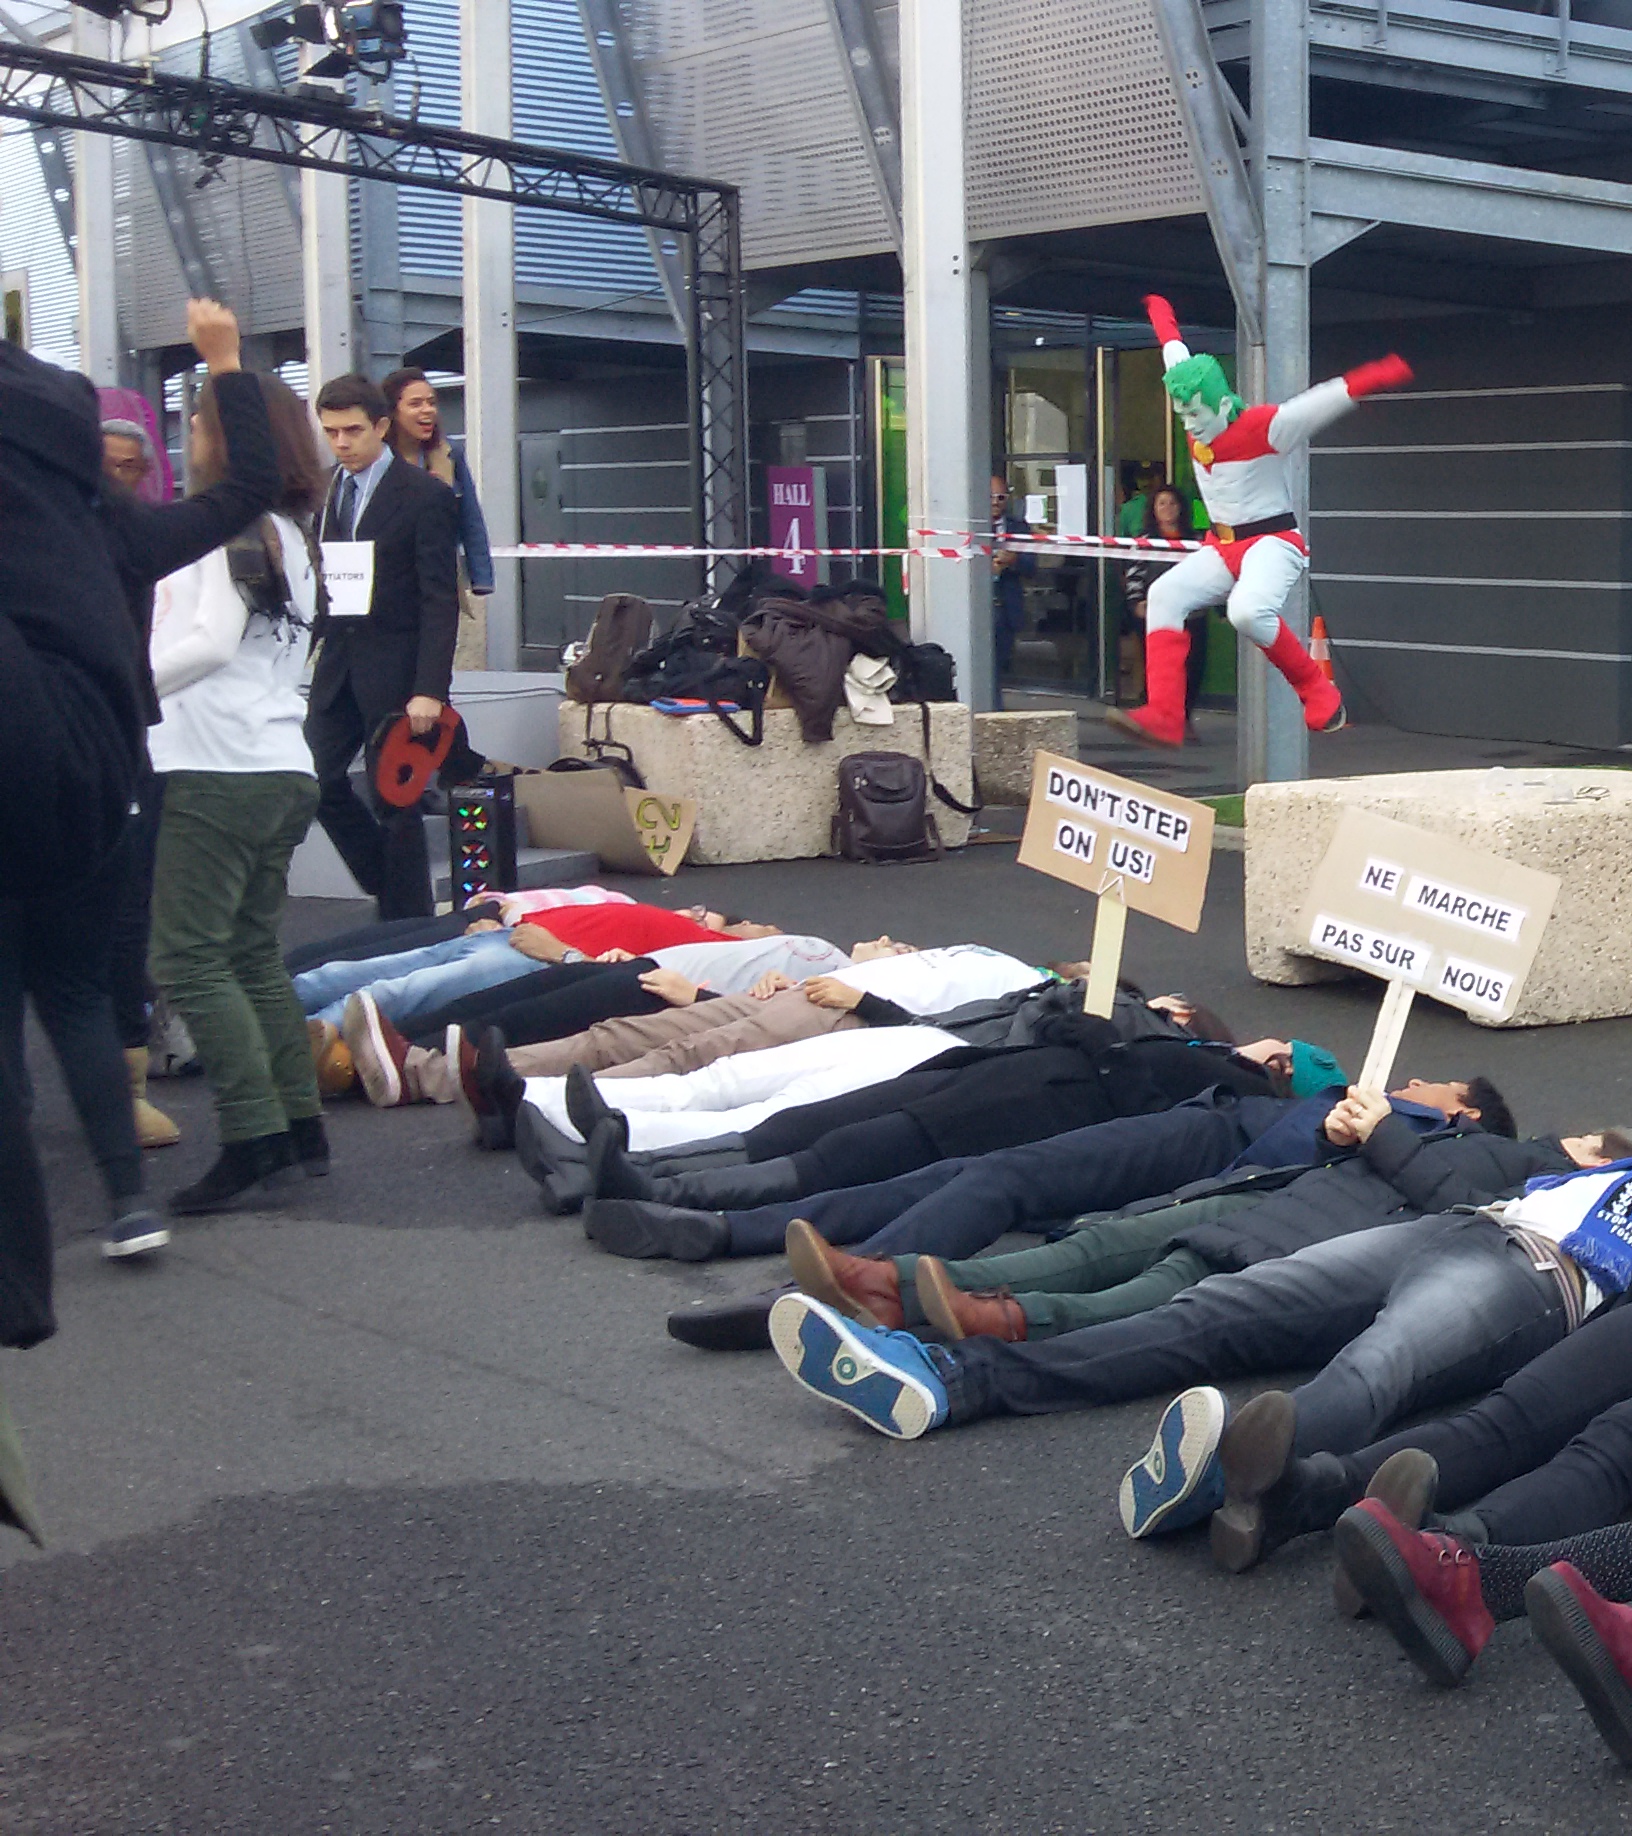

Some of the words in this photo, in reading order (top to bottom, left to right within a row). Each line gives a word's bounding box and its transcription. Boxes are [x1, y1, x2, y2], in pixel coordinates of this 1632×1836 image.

[773, 483, 811, 506] HALL
[783, 517, 806, 575] 4
[1050, 772, 1122, 818] DON'T
[1125, 799, 1188, 841] STEP
[1059, 825, 1092, 858] ON
[1112, 842, 1152, 878] US!
[1364, 865, 1397, 891] NE
[1417, 885, 1512, 932] MARCHE
[1321, 924, 1364, 953] PAS
[1369, 939, 1415, 970] SUR
[1442, 965, 1503, 1001] NOUS
[1597, 1209, 1628, 1225] STOP
